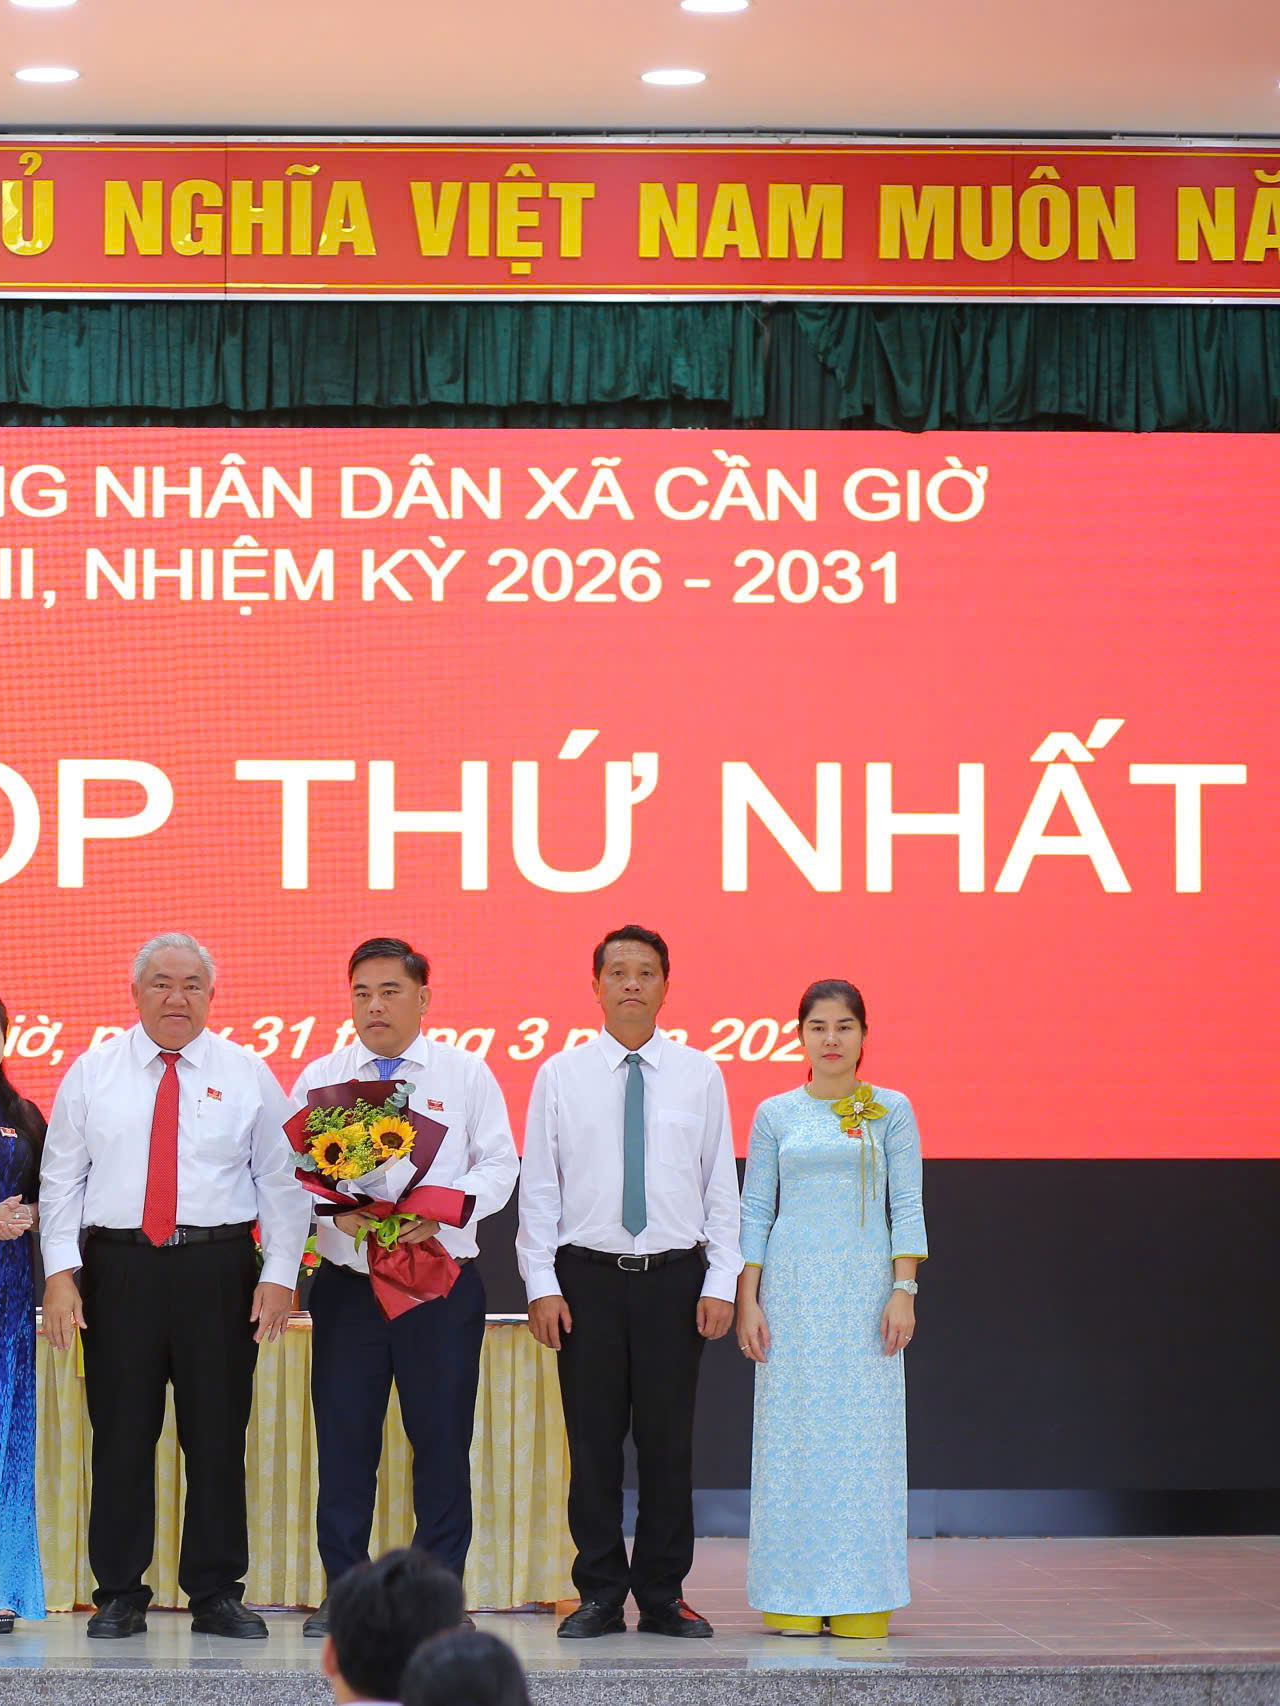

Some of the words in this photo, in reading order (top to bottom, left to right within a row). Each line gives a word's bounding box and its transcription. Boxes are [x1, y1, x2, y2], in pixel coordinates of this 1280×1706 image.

[104, 164, 376, 257] NGHĨA
[410, 163, 596, 275] VIỆT
[639, 183, 844, 260] NAM
[879, 165, 1136, 261] MUÔN
[95, 453, 312, 518] NHÂN
[340, 454, 501, 519] DÂN
[526, 456, 633, 520] XÃ
[655, 449, 817, 520] CẦN
[843, 456, 988, 522] GIỜ
[0, 548, 56, 608] II,
[86, 534, 334, 615] NHIỆM
[363, 535, 466, 602] KỲ
[488, 548, 662, 602] 2026
[684, 578, 711, 588] -
[732, 549, 897, 604] 2031
[236, 730, 658, 892] THỨ
[722, 719, 1247, 893] NHẤT
[3, 1014, 64, 1066] iờ,
[241, 1016, 316, 1059] 31
[508, 1017, 549, 1061] 3
[704, 1017, 806, 1062] 202
